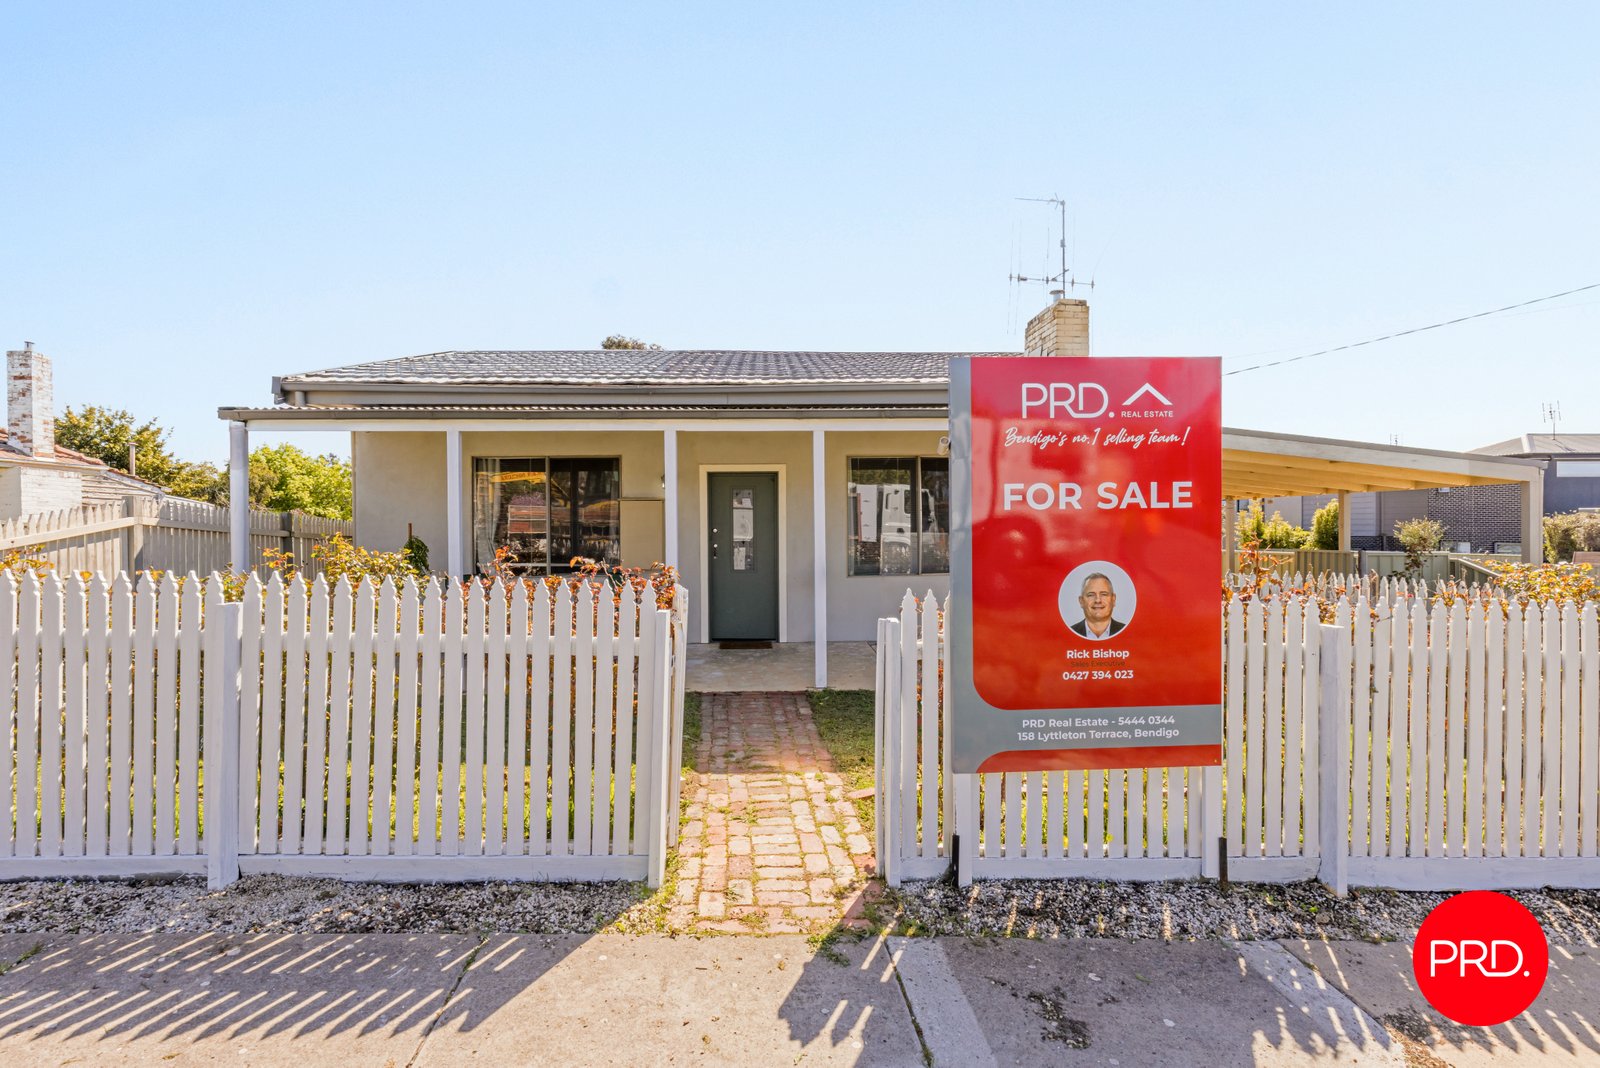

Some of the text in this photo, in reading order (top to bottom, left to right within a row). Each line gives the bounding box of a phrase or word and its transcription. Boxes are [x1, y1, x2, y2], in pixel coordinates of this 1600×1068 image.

[1144, 410, 1174, 418] ESTATE
[1004, 426, 1067, 449] Bendigo's
[1103, 427, 1146, 449] selling
[1003, 481, 1193, 511] FOR SALE
[1066, 648, 1130, 659] Rick Bishop
[1062, 669, 1134, 680] 0427 394 023
[1022, 719, 1046, 728] PRD
[1049, 718, 1072, 728] Real
[1075, 717, 1109, 727] Estate
[1118, 716, 1146, 726] 5444
[1148, 715, 1175, 725] 0344
[1017, 728, 1180, 742] 158 Lyttleton Terrace, Bendigo
